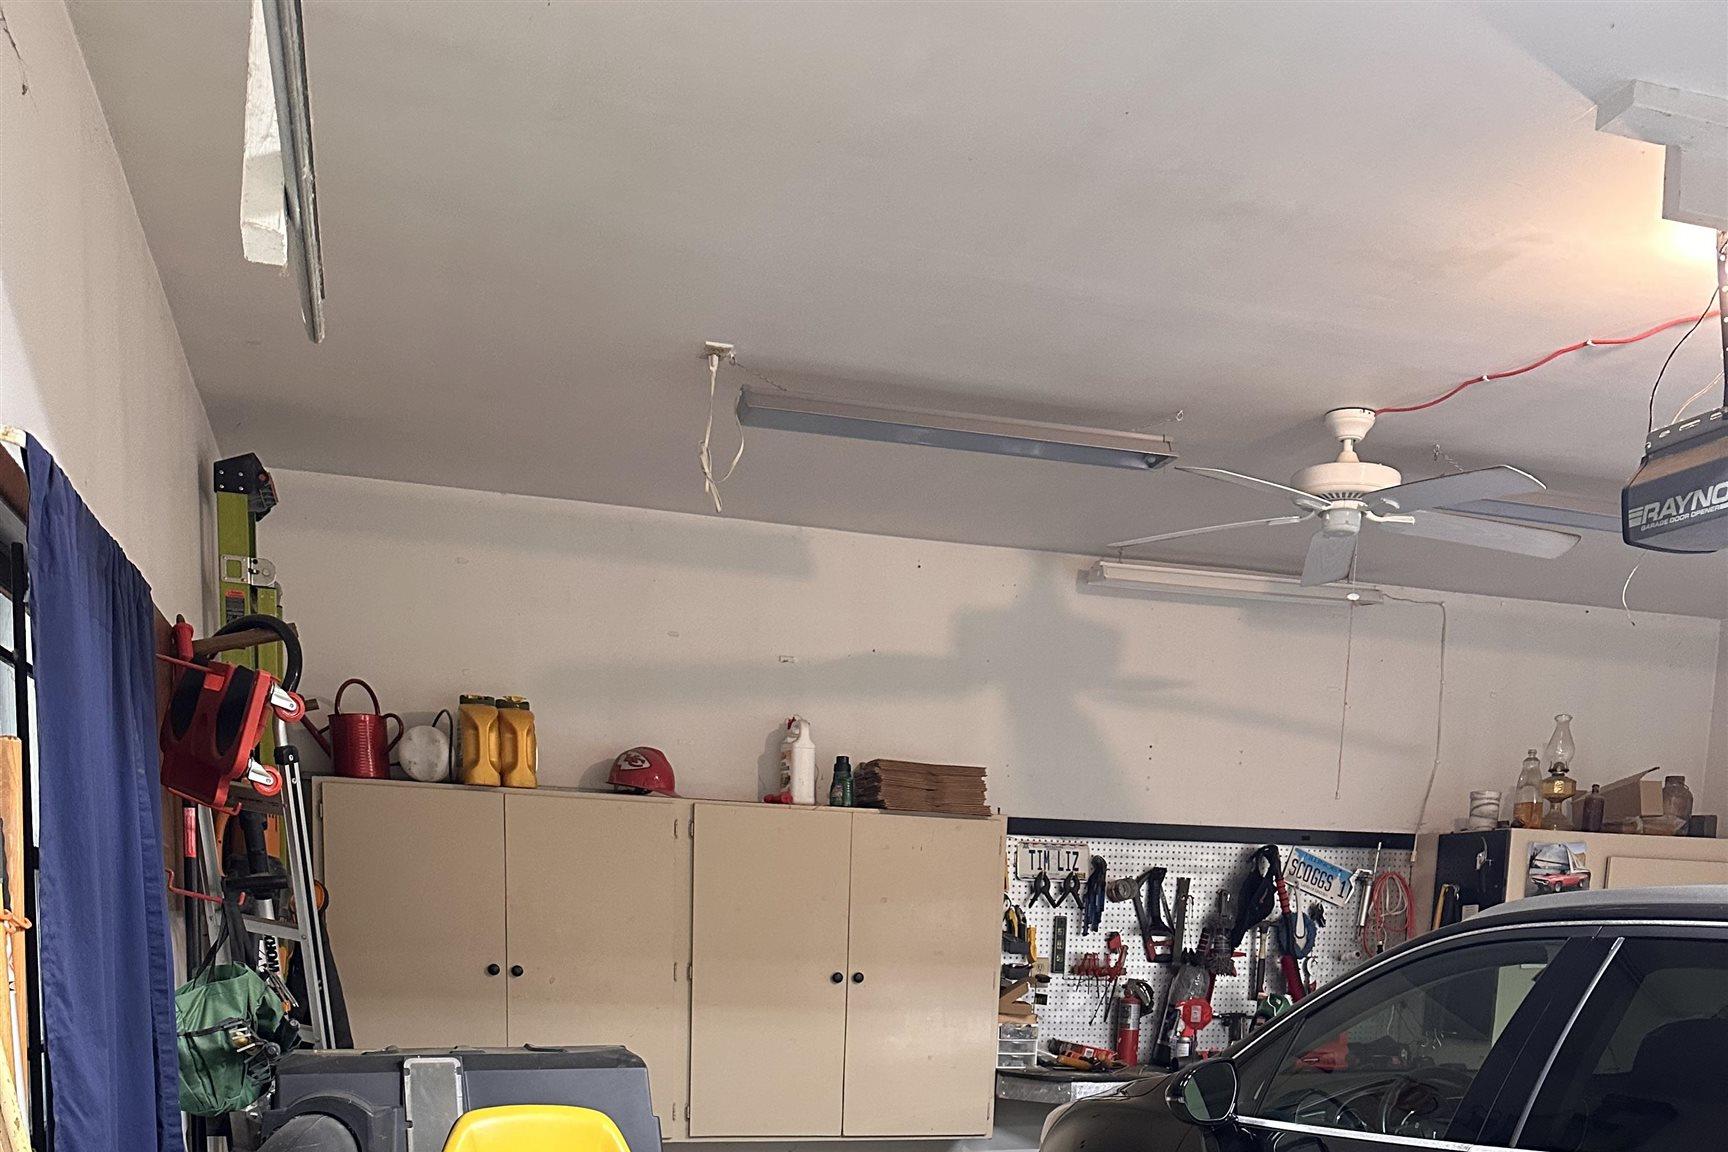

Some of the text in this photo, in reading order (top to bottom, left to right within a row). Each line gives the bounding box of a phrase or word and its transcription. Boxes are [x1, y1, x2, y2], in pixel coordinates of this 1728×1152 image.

[1641, 481, 1728, 524] RAYNO
[1640, 518, 1669, 531] GARAGE
[1669, 512, 1690, 523] DOOR
[1028, 849, 1080, 872] TIM LIZ
[1288, 858, 1334, 892] SCOGGS
[1337, 880, 1347, 899] 1
